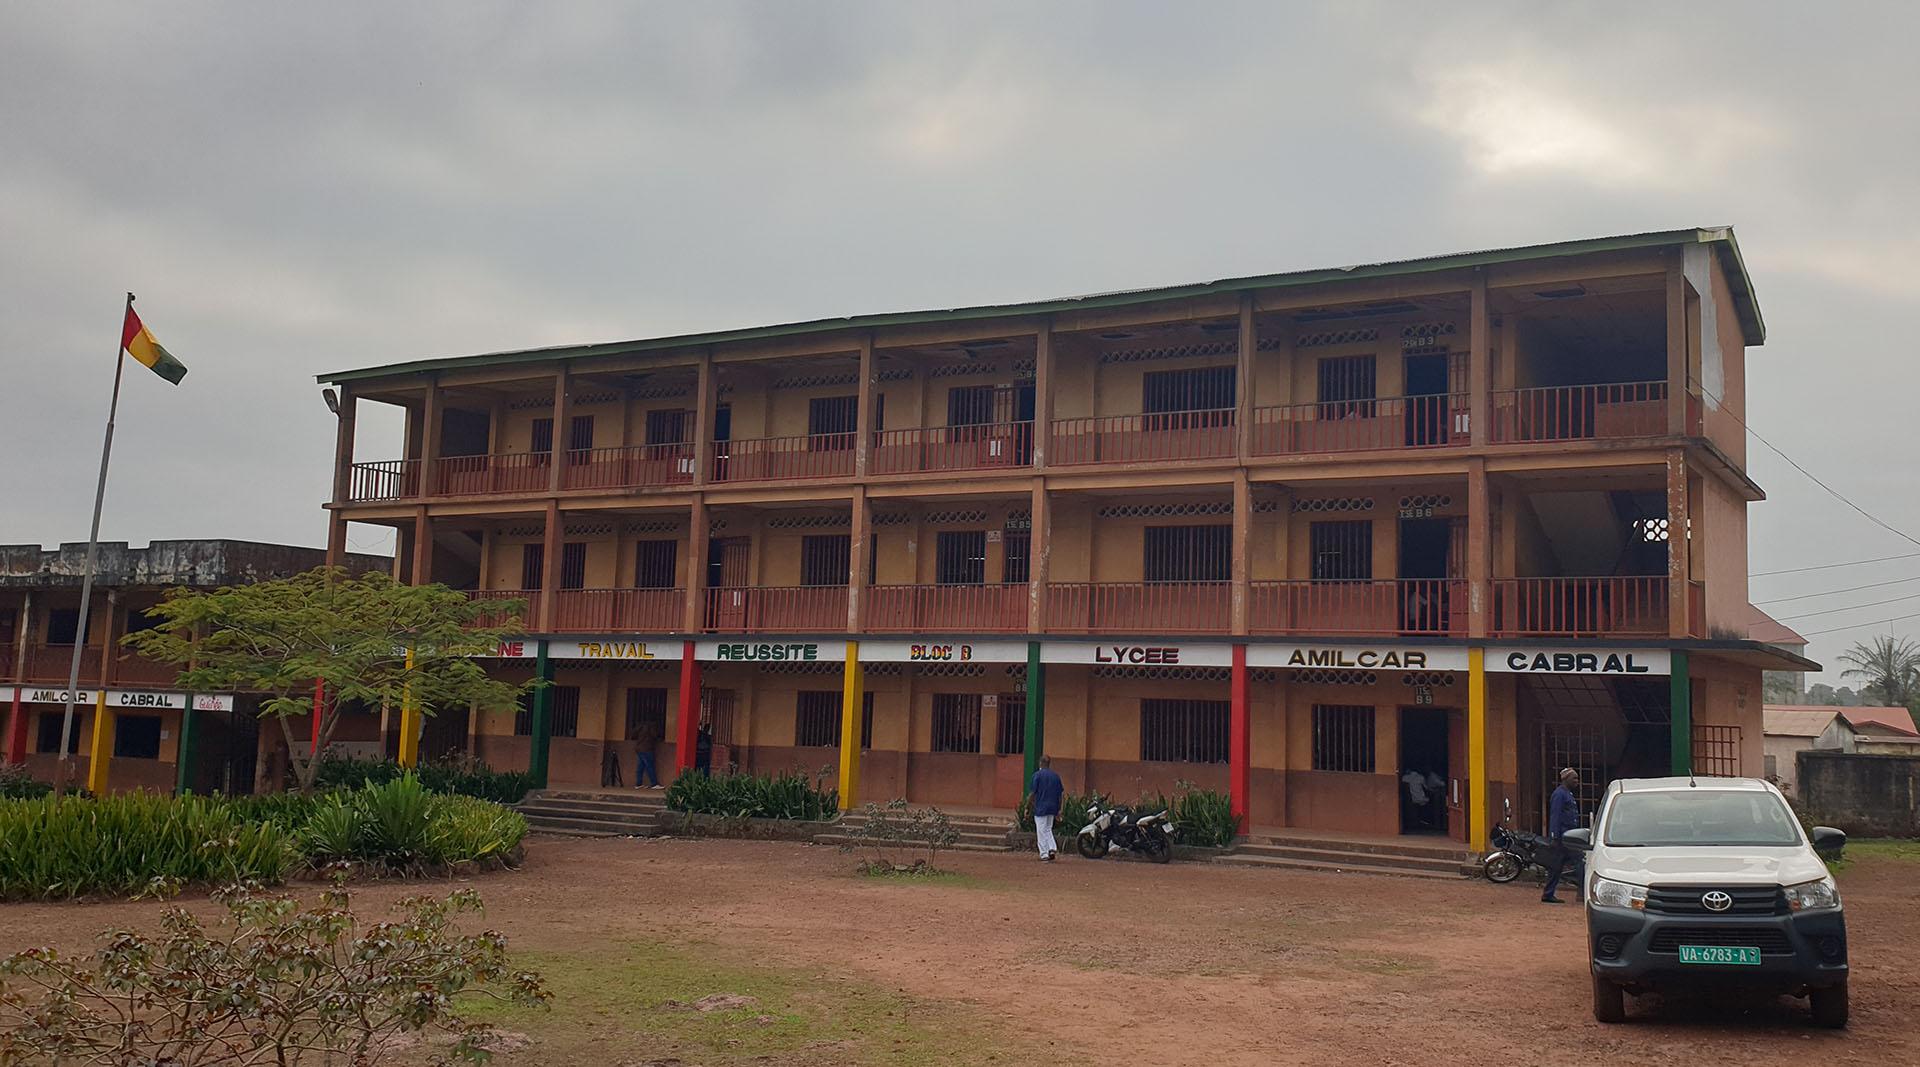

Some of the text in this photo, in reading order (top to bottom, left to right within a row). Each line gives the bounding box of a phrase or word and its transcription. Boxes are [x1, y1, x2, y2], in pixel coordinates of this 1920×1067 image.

[579, 643, 654, 658] TRAVAIL
[717, 644, 817, 660] REUSSITE
[911, 645, 972, 660] BLOC B
[1096, 647, 1180, 664] LYCEE
[1288, 650, 1427, 668] AMILCAR
[1507, 652, 1648, 672] CABRAL
[120, 693, 172, 706] CABRAL
[1682, 948, 1747, 961] VA-6783-A
